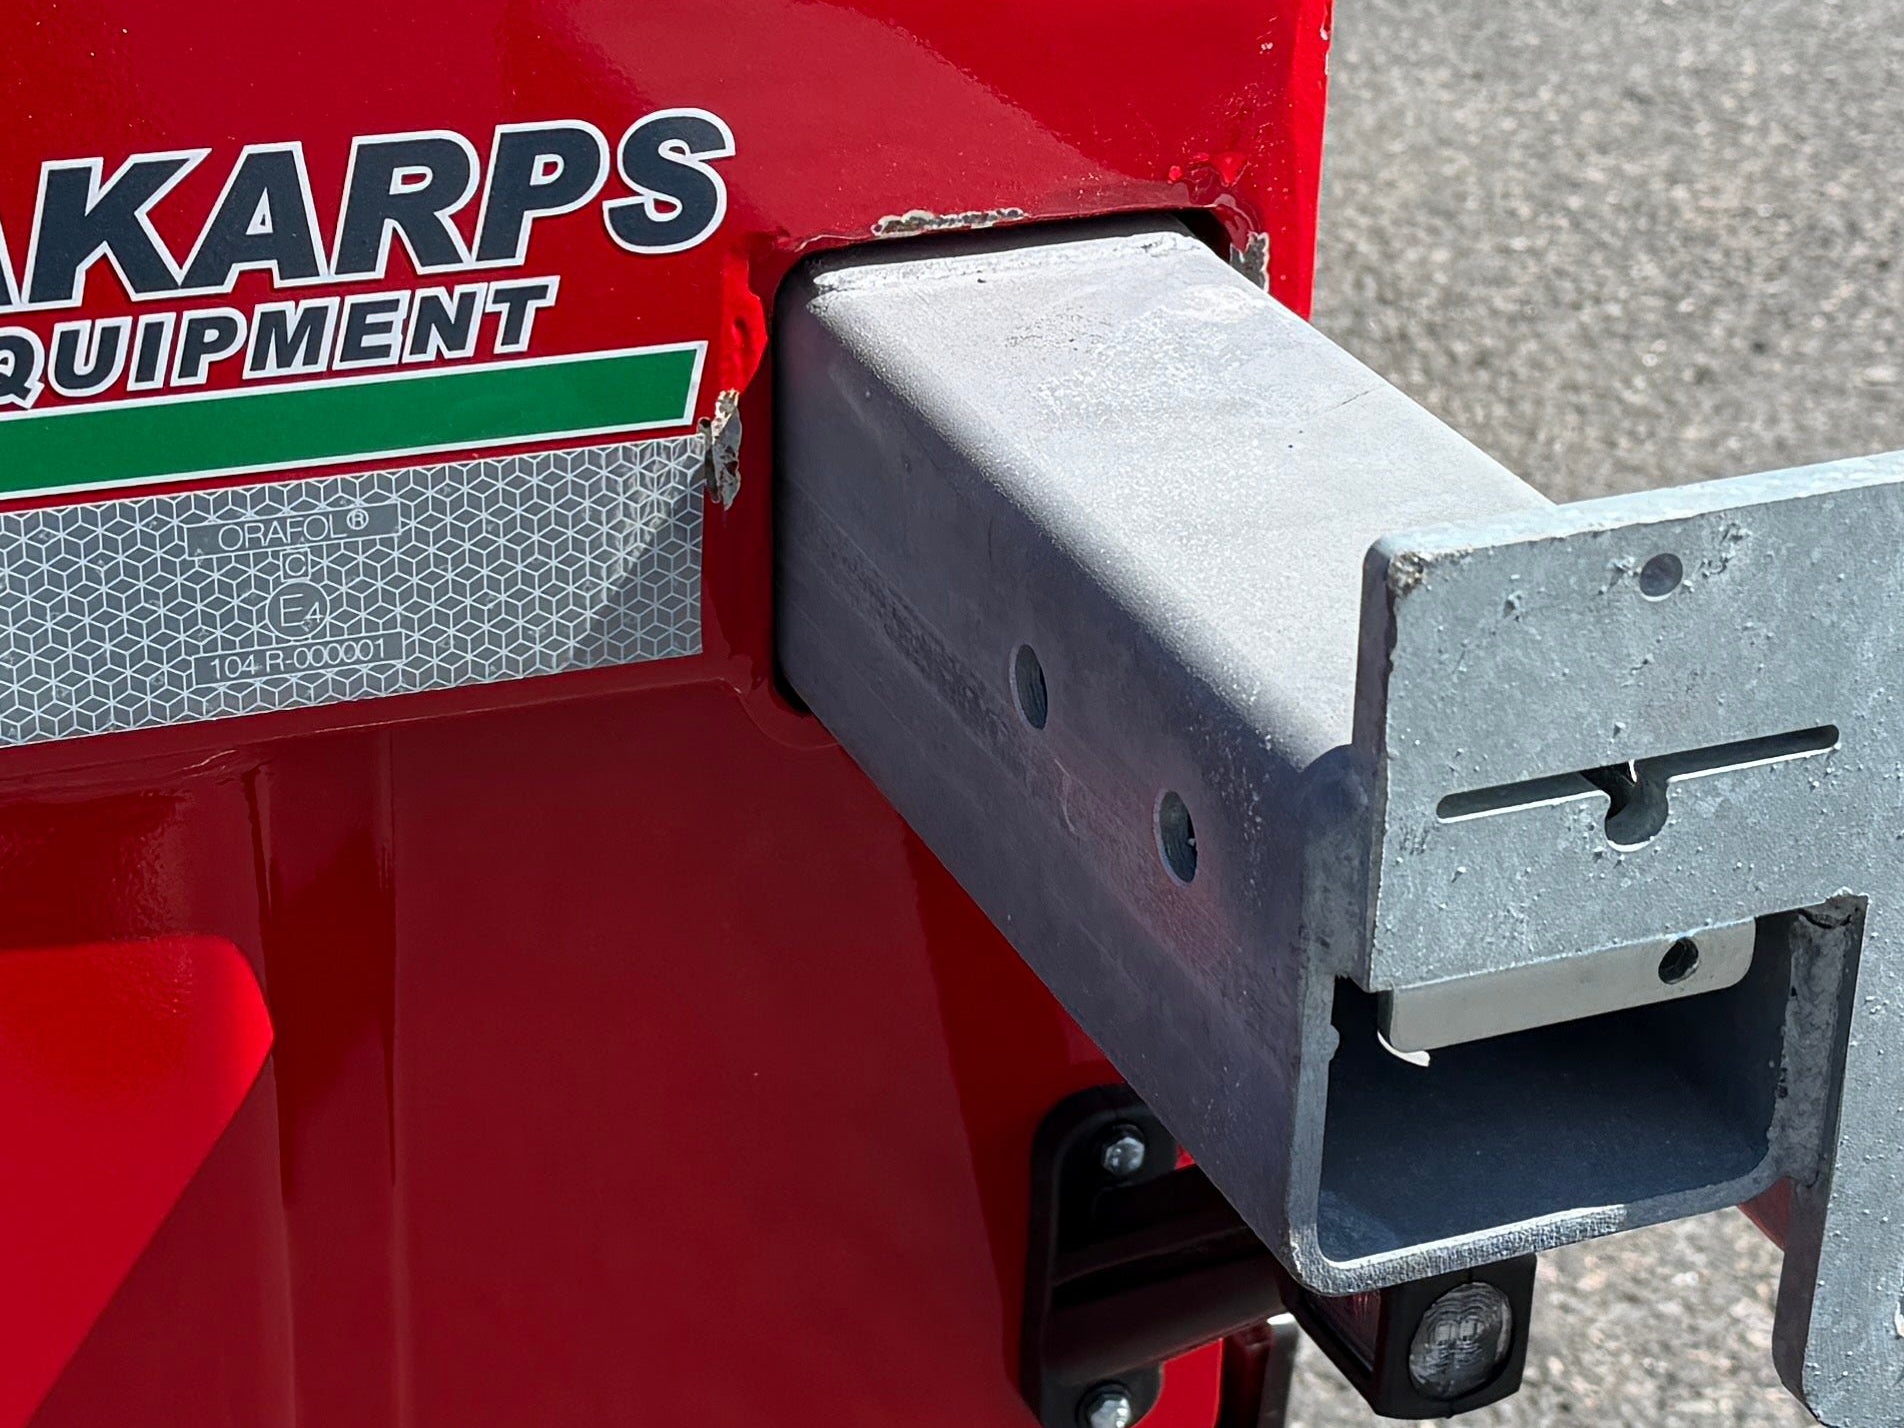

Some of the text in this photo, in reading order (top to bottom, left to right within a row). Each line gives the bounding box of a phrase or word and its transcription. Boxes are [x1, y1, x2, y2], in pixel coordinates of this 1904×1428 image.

[285, 554, 306, 576] C
[280, 593, 324, 628] E4
[210, 638, 385, 680] 104 R-000001
